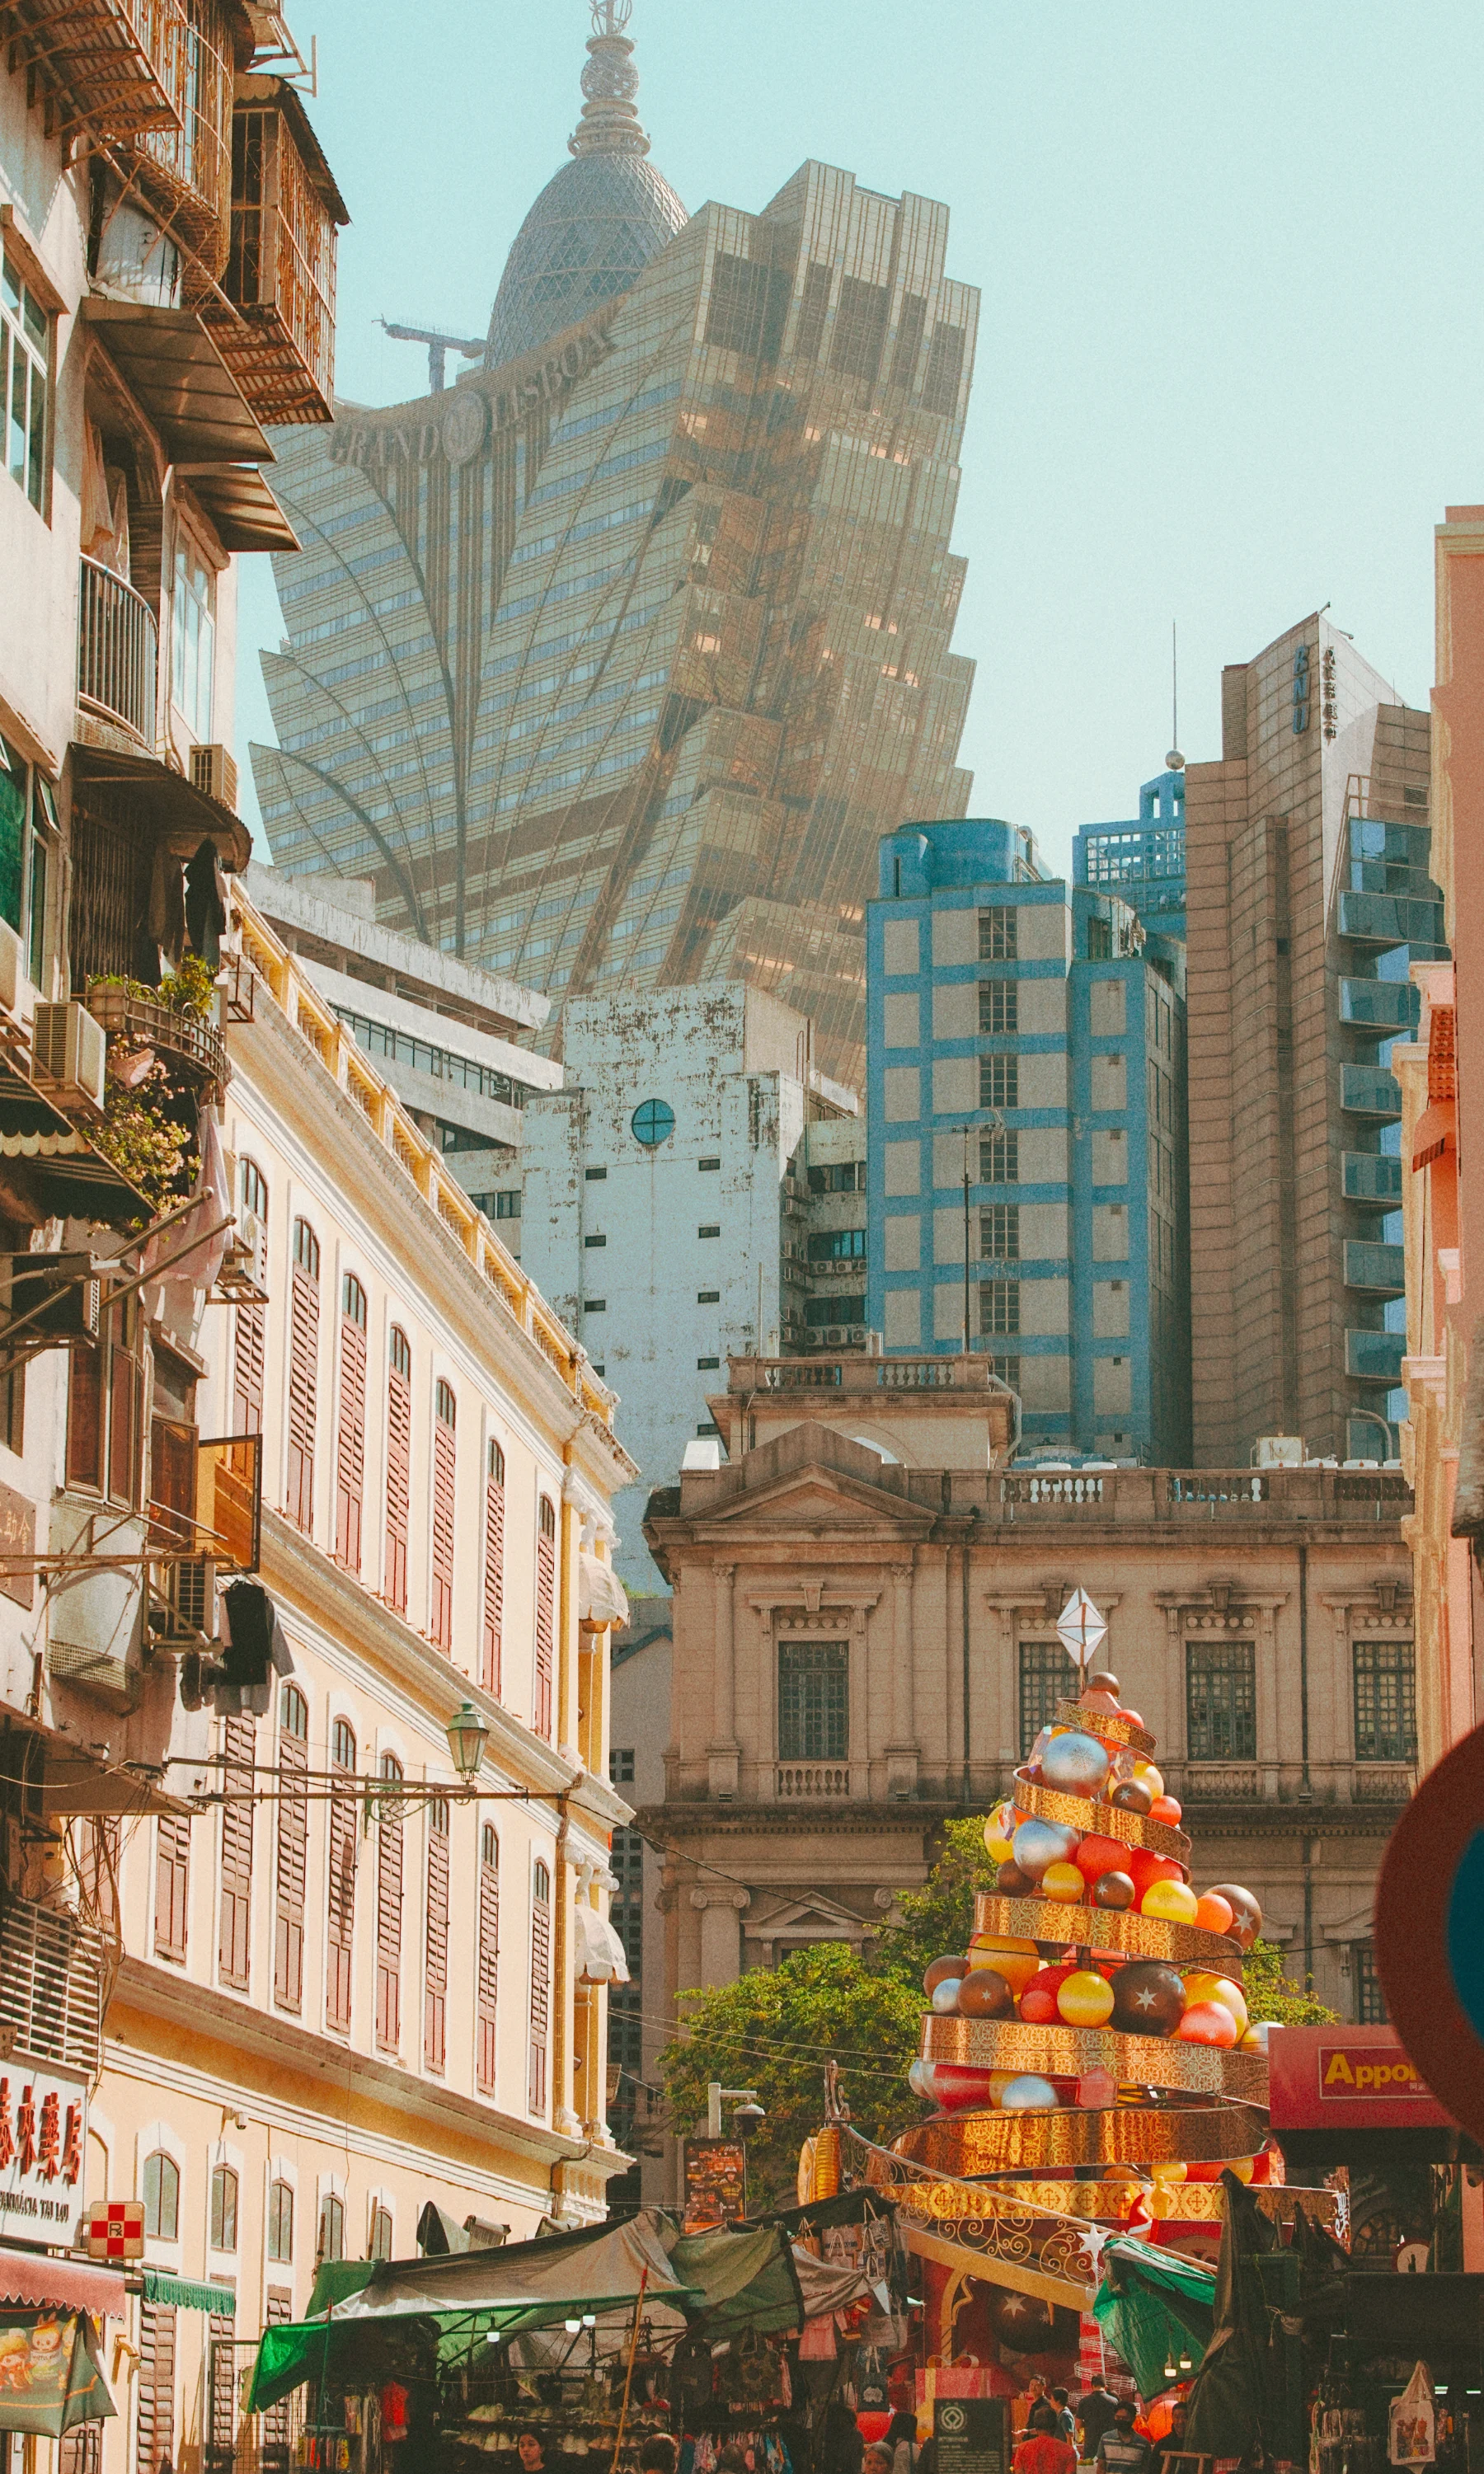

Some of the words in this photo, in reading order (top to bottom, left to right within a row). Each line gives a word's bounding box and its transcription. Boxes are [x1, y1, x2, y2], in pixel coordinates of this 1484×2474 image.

[328, 423, 440, 467] GRAND
[491, 327, 615, 435] LISBOA
[1293, 645, 1308, 735] BNU
